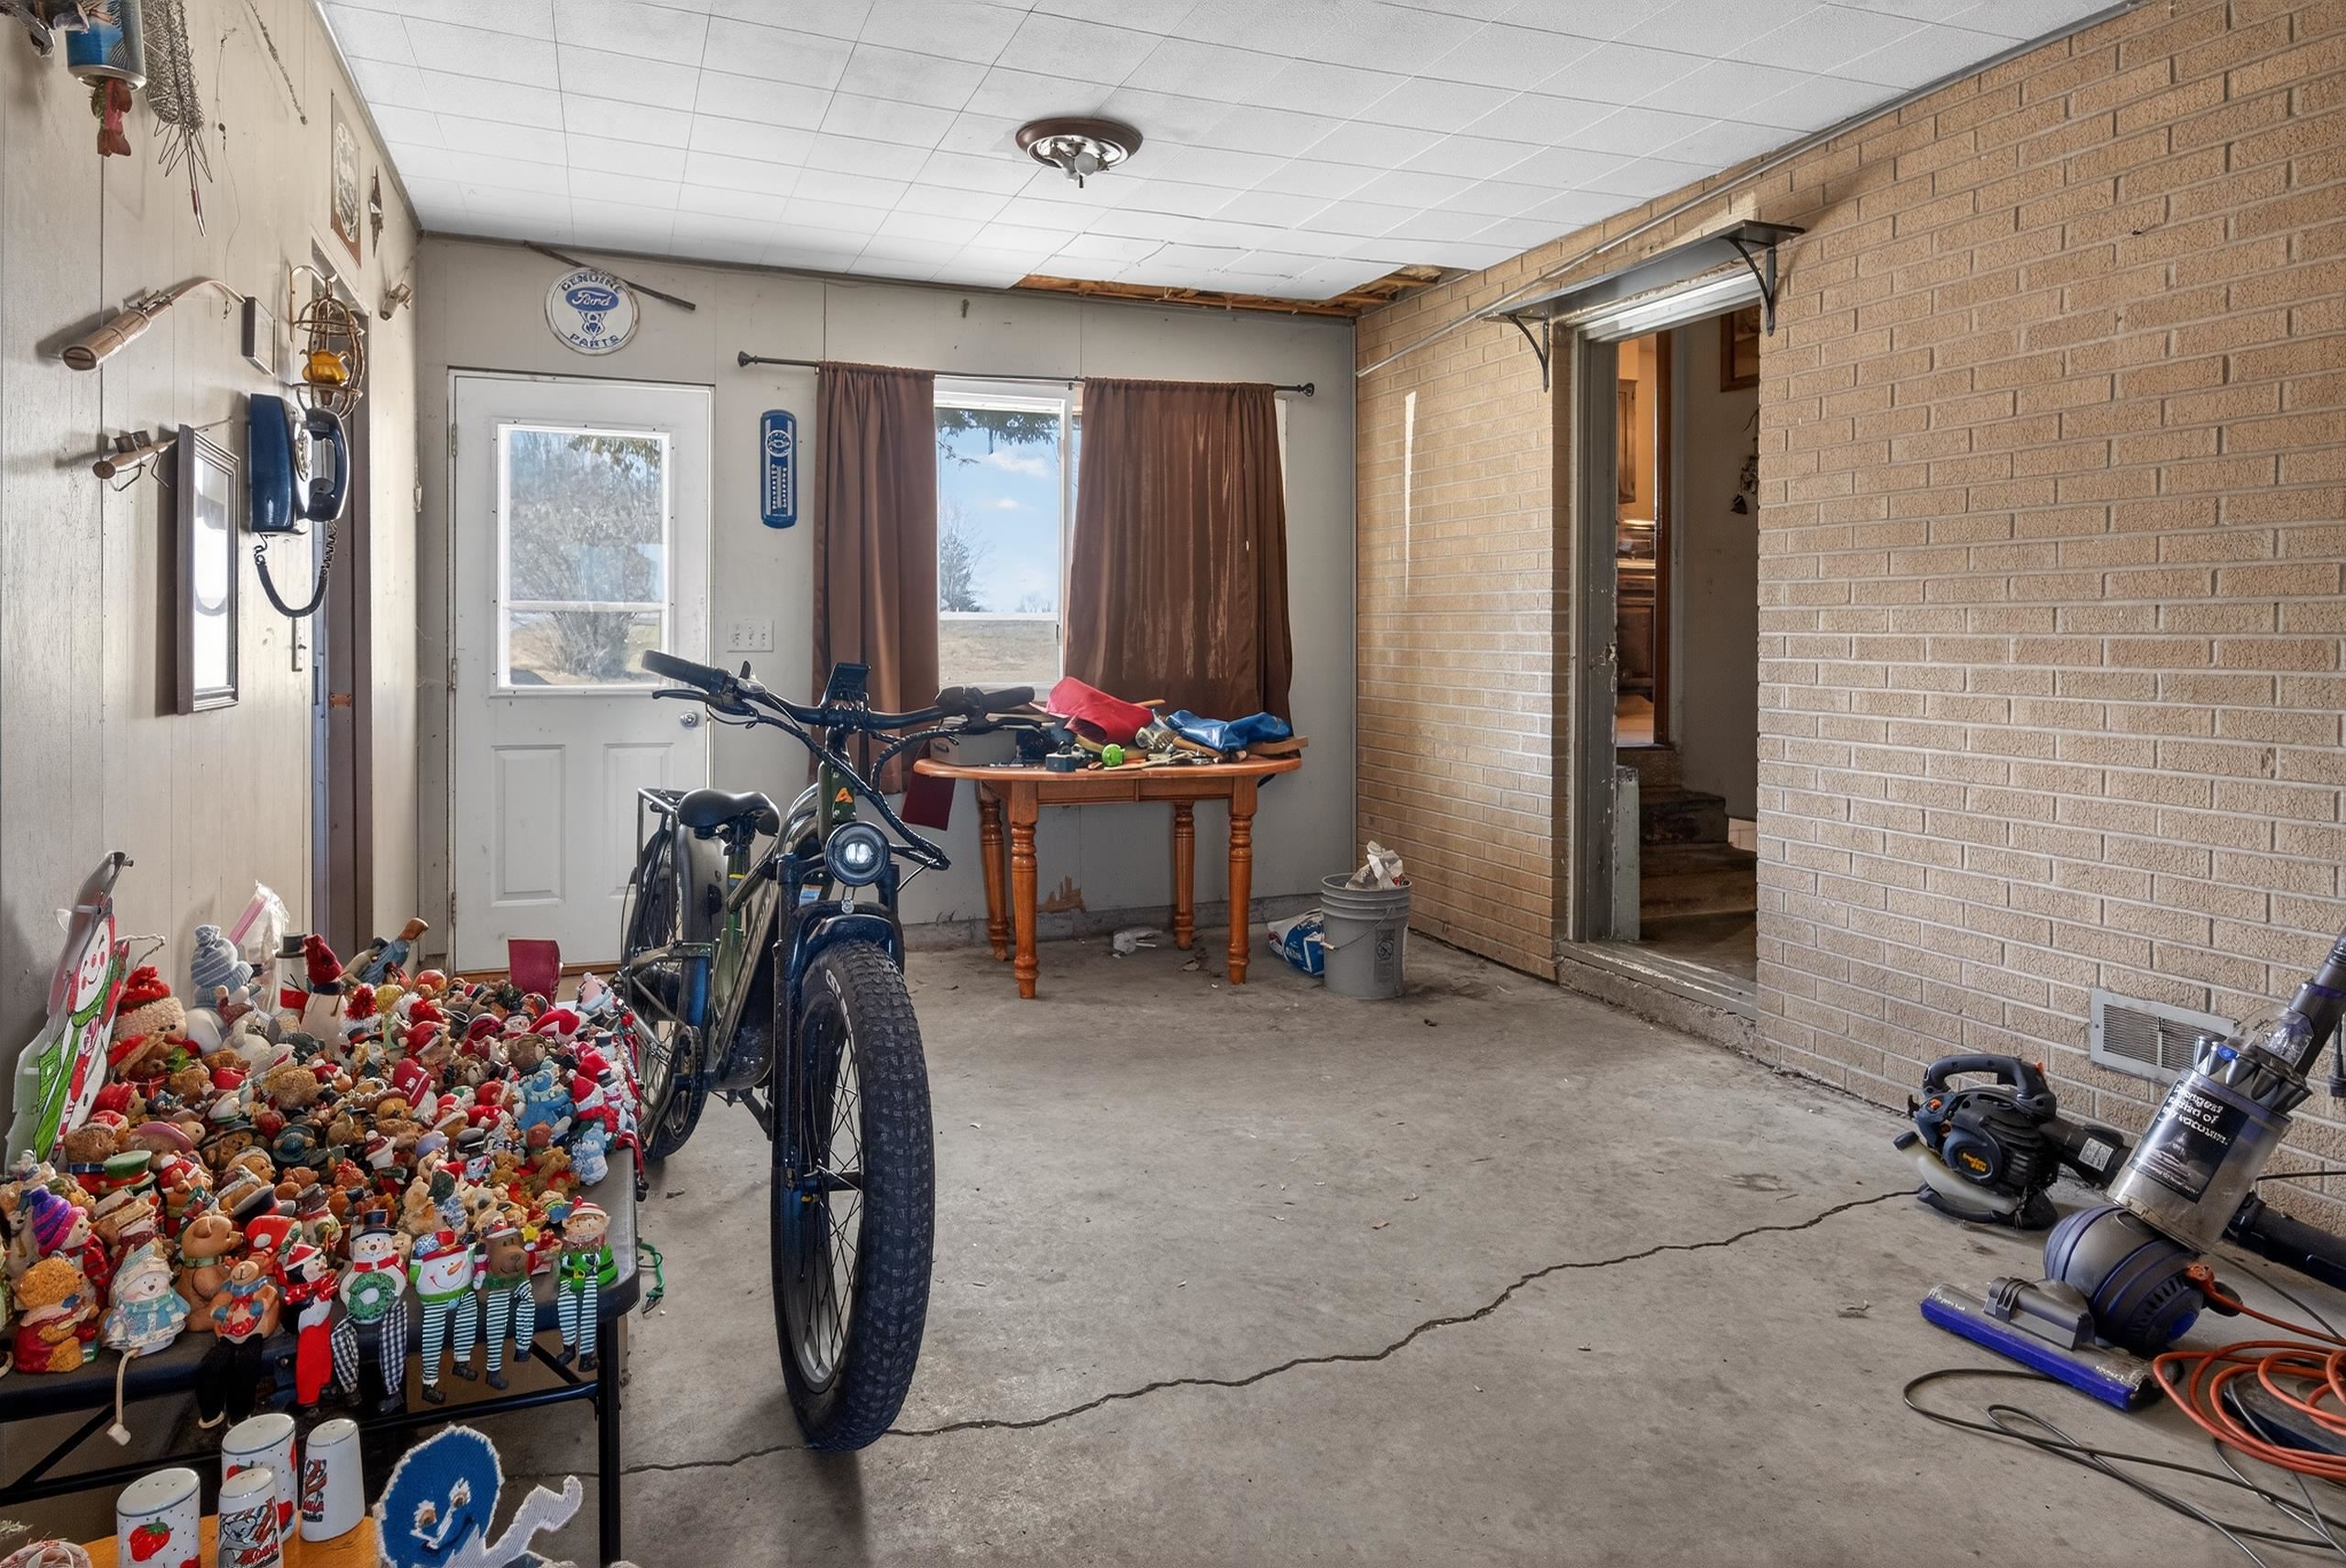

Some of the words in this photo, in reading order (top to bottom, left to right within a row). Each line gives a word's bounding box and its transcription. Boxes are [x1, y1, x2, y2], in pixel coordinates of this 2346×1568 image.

[572, 290, 612, 307] Ford
[570, 333, 619, 347] PARTS
[2202, 1113, 2220, 1124] of
